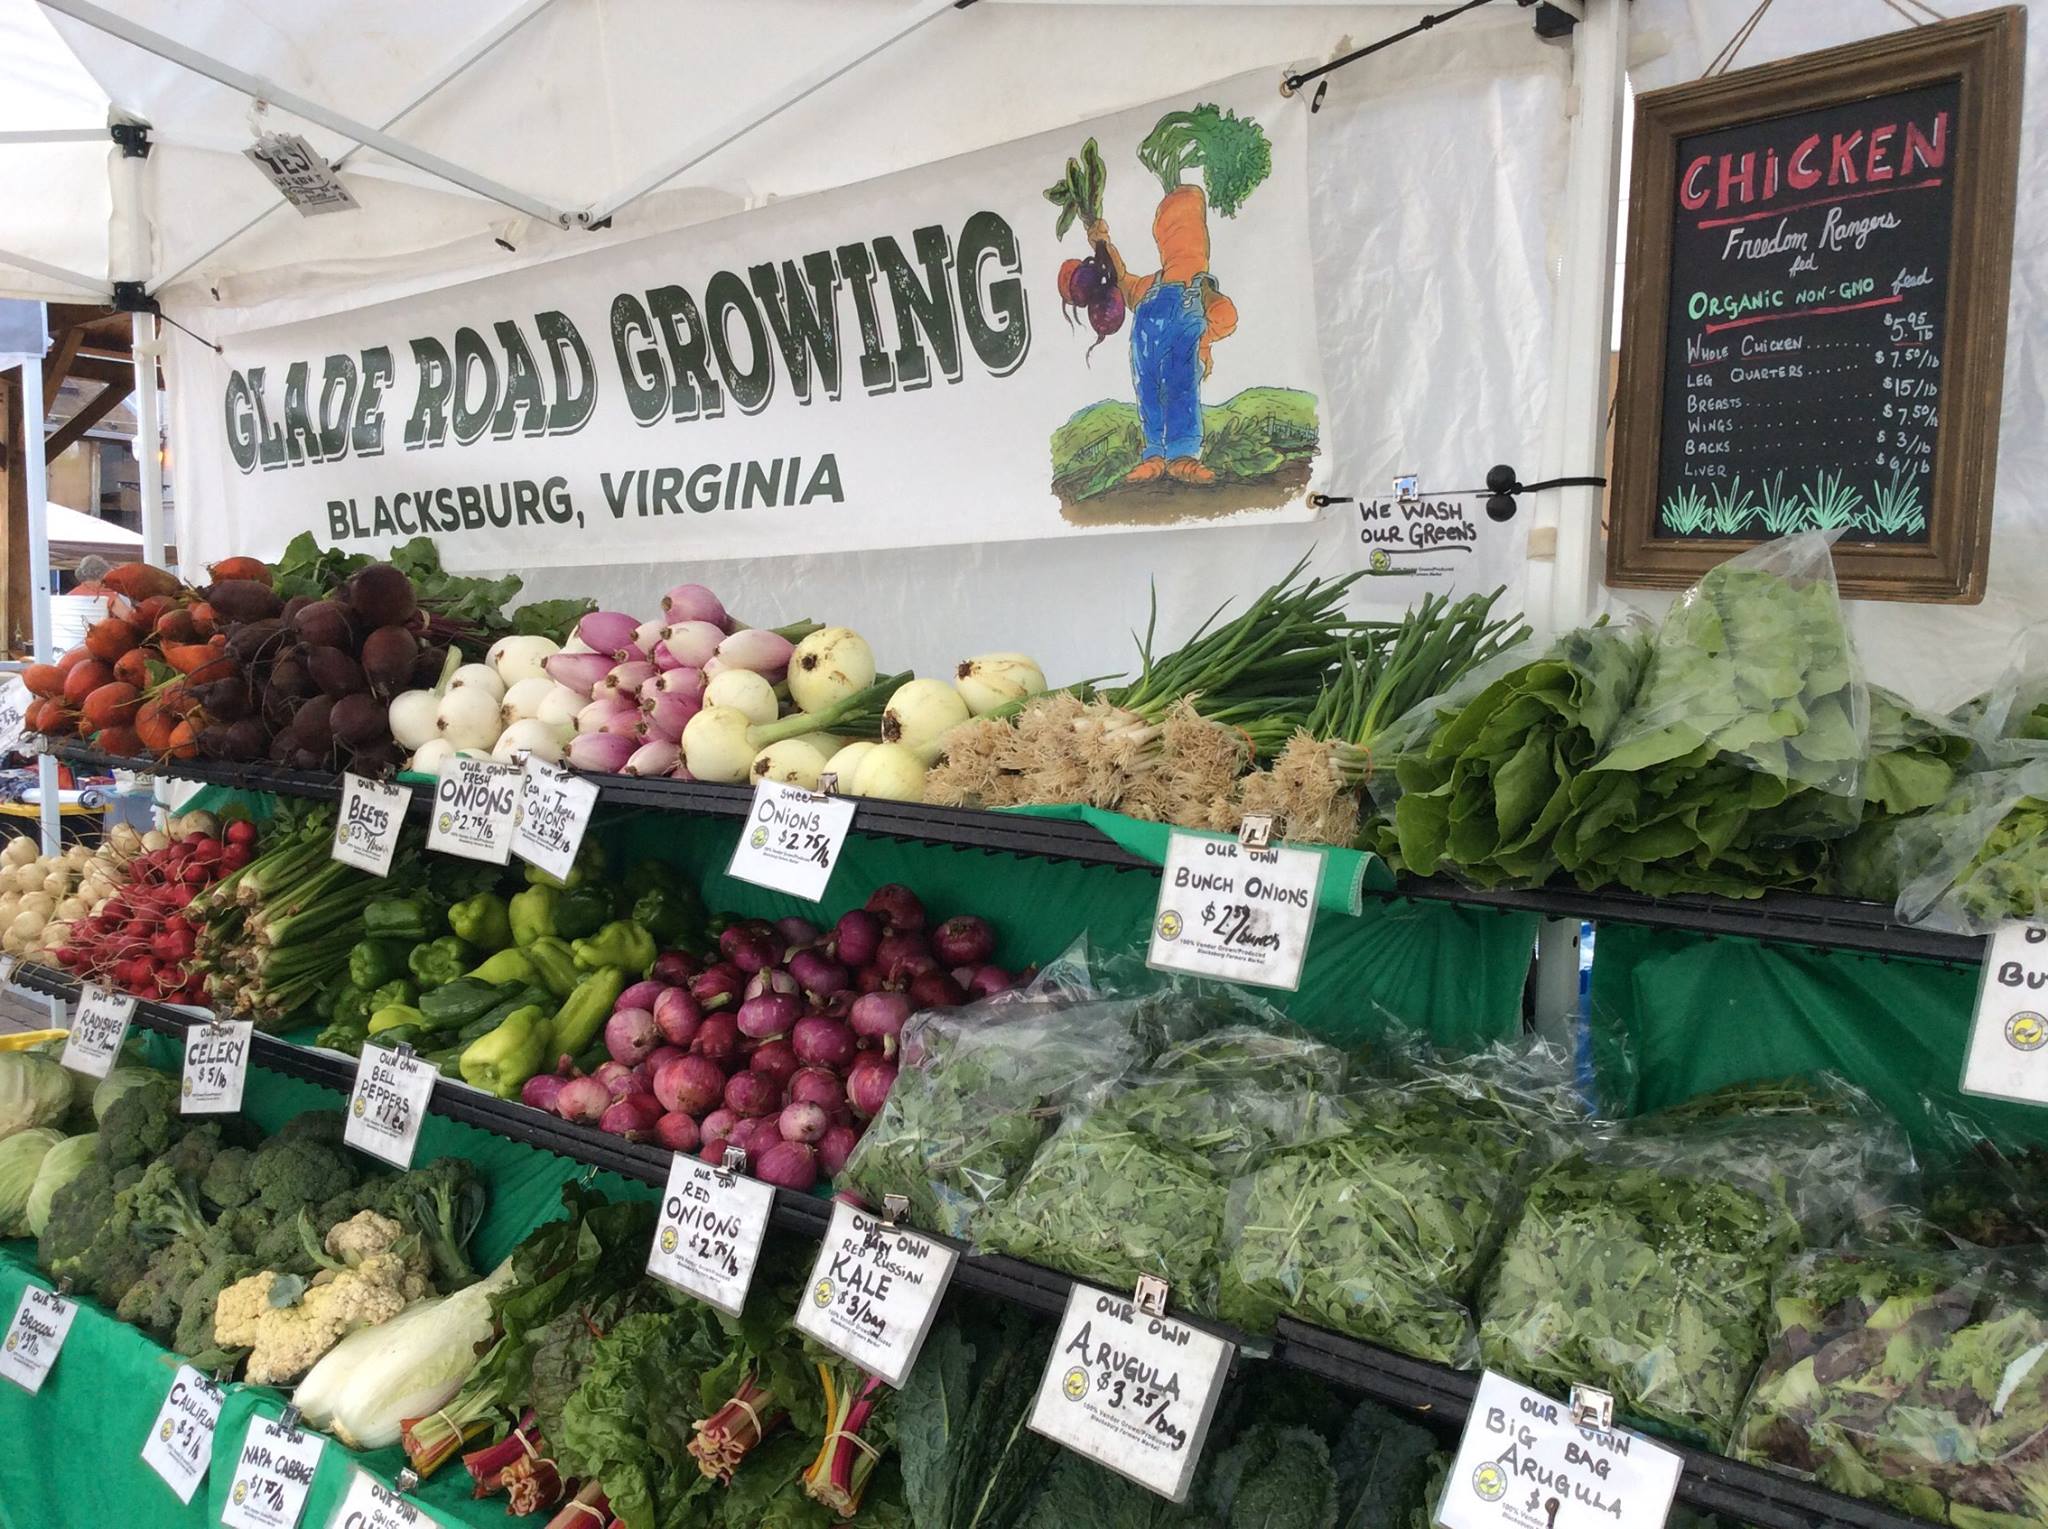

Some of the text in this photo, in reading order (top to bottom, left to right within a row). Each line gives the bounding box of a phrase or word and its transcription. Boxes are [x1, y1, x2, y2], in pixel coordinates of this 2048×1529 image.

[1722, 206, 1902, 260] Freedom Rangers
[1796, 278, 1874, 304] NON-GMO
[225, 211, 1032, 474] GLADE ROAD GROWING
[1687, 334, 1729, 364] WHOLE
[1687, 374, 1713, 388] LEG
[1730, 365, 1803, 383] QUARTERS
[1687, 395, 1742, 413] BREASTS
[1684, 440, 1731, 455] BACKS
[327, 453, 845, 540] BLACKSBURG, VIRGINIA
[1360, 500, 1463, 521] WE WASH
[460, 761, 482, 773] OUR
[348, 794, 389, 829] BEETS
[440, 778, 514, 816] ONIONS
[528, 800, 567, 832] ONIONS
[1204, 842, 1279, 865] OUR OWN
[1174, 866, 1309, 909] BUNCH ONIONS
[188, 1040, 245, 1067] CELERY
[371, 1065, 396, 1086] BELL
[360, 1079, 410, 1114] PEPPERS
[693, 1167, 712, 1181] OUR
[682, 1181, 711, 1204] RED
[842, 1238, 866, 1259] RED
[896, 1236, 930, 1259] OWN
[828, 1251, 893, 1302] KALE
[1096, 1295, 1191, 1347] OUR OWN
[1065, 1320, 1181, 1402] ARUGULA
[1520, 1396, 1559, 1426] OUR
[241, 1445, 272, 1469] NAPA
[1564, 1441, 1612, 1481] BAG
[1496, 1442, 1622, 1519] ARUGULA
